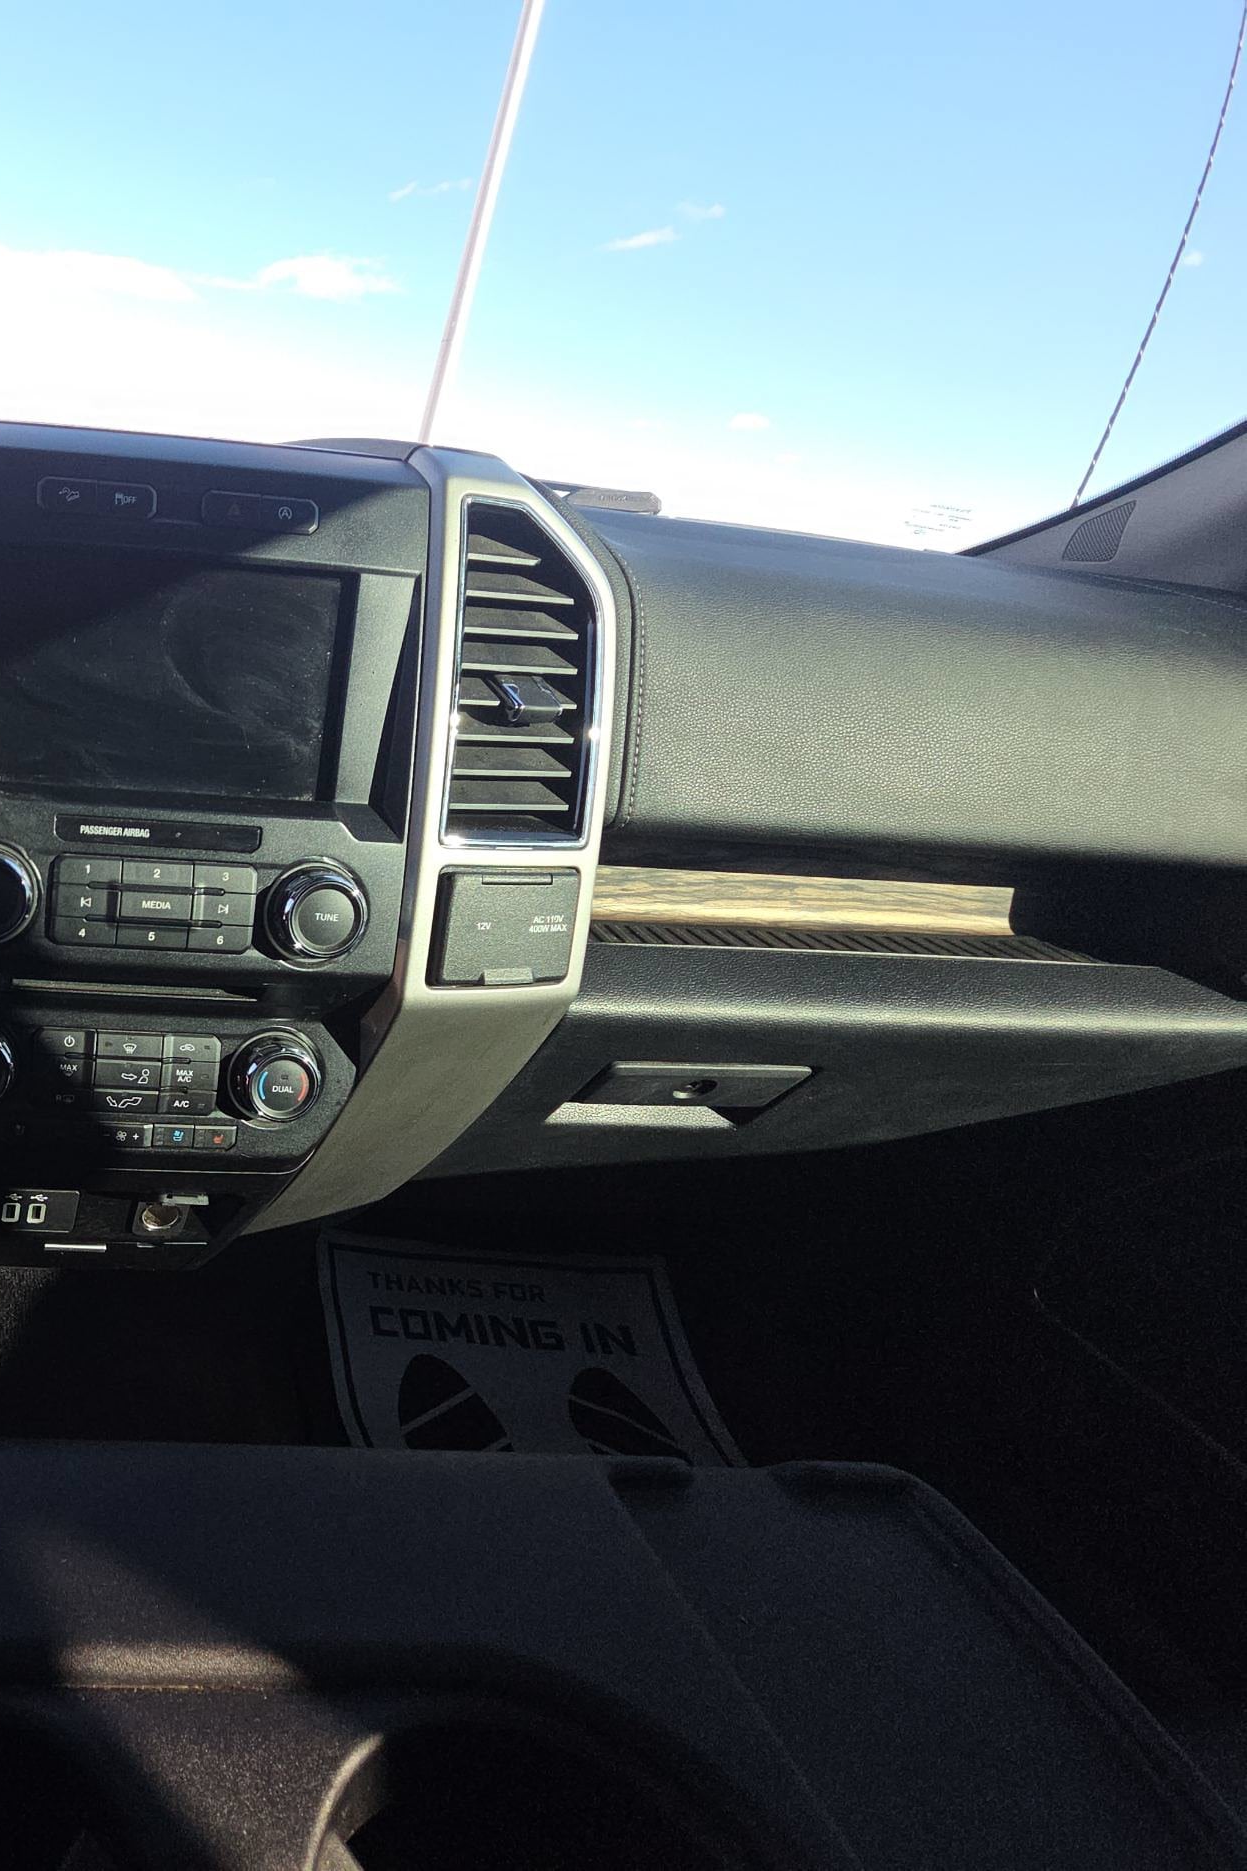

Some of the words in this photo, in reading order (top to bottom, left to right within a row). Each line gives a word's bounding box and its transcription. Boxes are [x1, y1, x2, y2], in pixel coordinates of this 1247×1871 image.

[79, 824, 123, 837] PASSENGER
[123, 827, 151, 839] AIRBAG
[84, 864, 91, 874] 1
[153, 868, 161, 878] 2
[221, 871, 229, 881] 3
[142, 900, 171, 910] MEDIA
[314, 912, 339, 922] TUNE
[533, 915, 545, 924] AC
[476, 922, 491, 930] 12V
[528, 924, 549, 933] 400W
[550, 924, 568, 932] MAX
[78, 928, 86, 938] 4
[148, 931, 156, 941] 5
[216, 935, 224, 945] 6
[59, 1064, 78, 1072] MAX
[175, 1069, 194, 1077] MAX
[272, 1085, 294, 1093] DUAL
[173, 1100, 190, 1108] A/C
[366, 1271, 484, 1300] THANKS
[492, 1281, 545, 1303] FOR
[369, 1305, 566, 1351] COMING
[579, 1320, 639, 1356] IN
